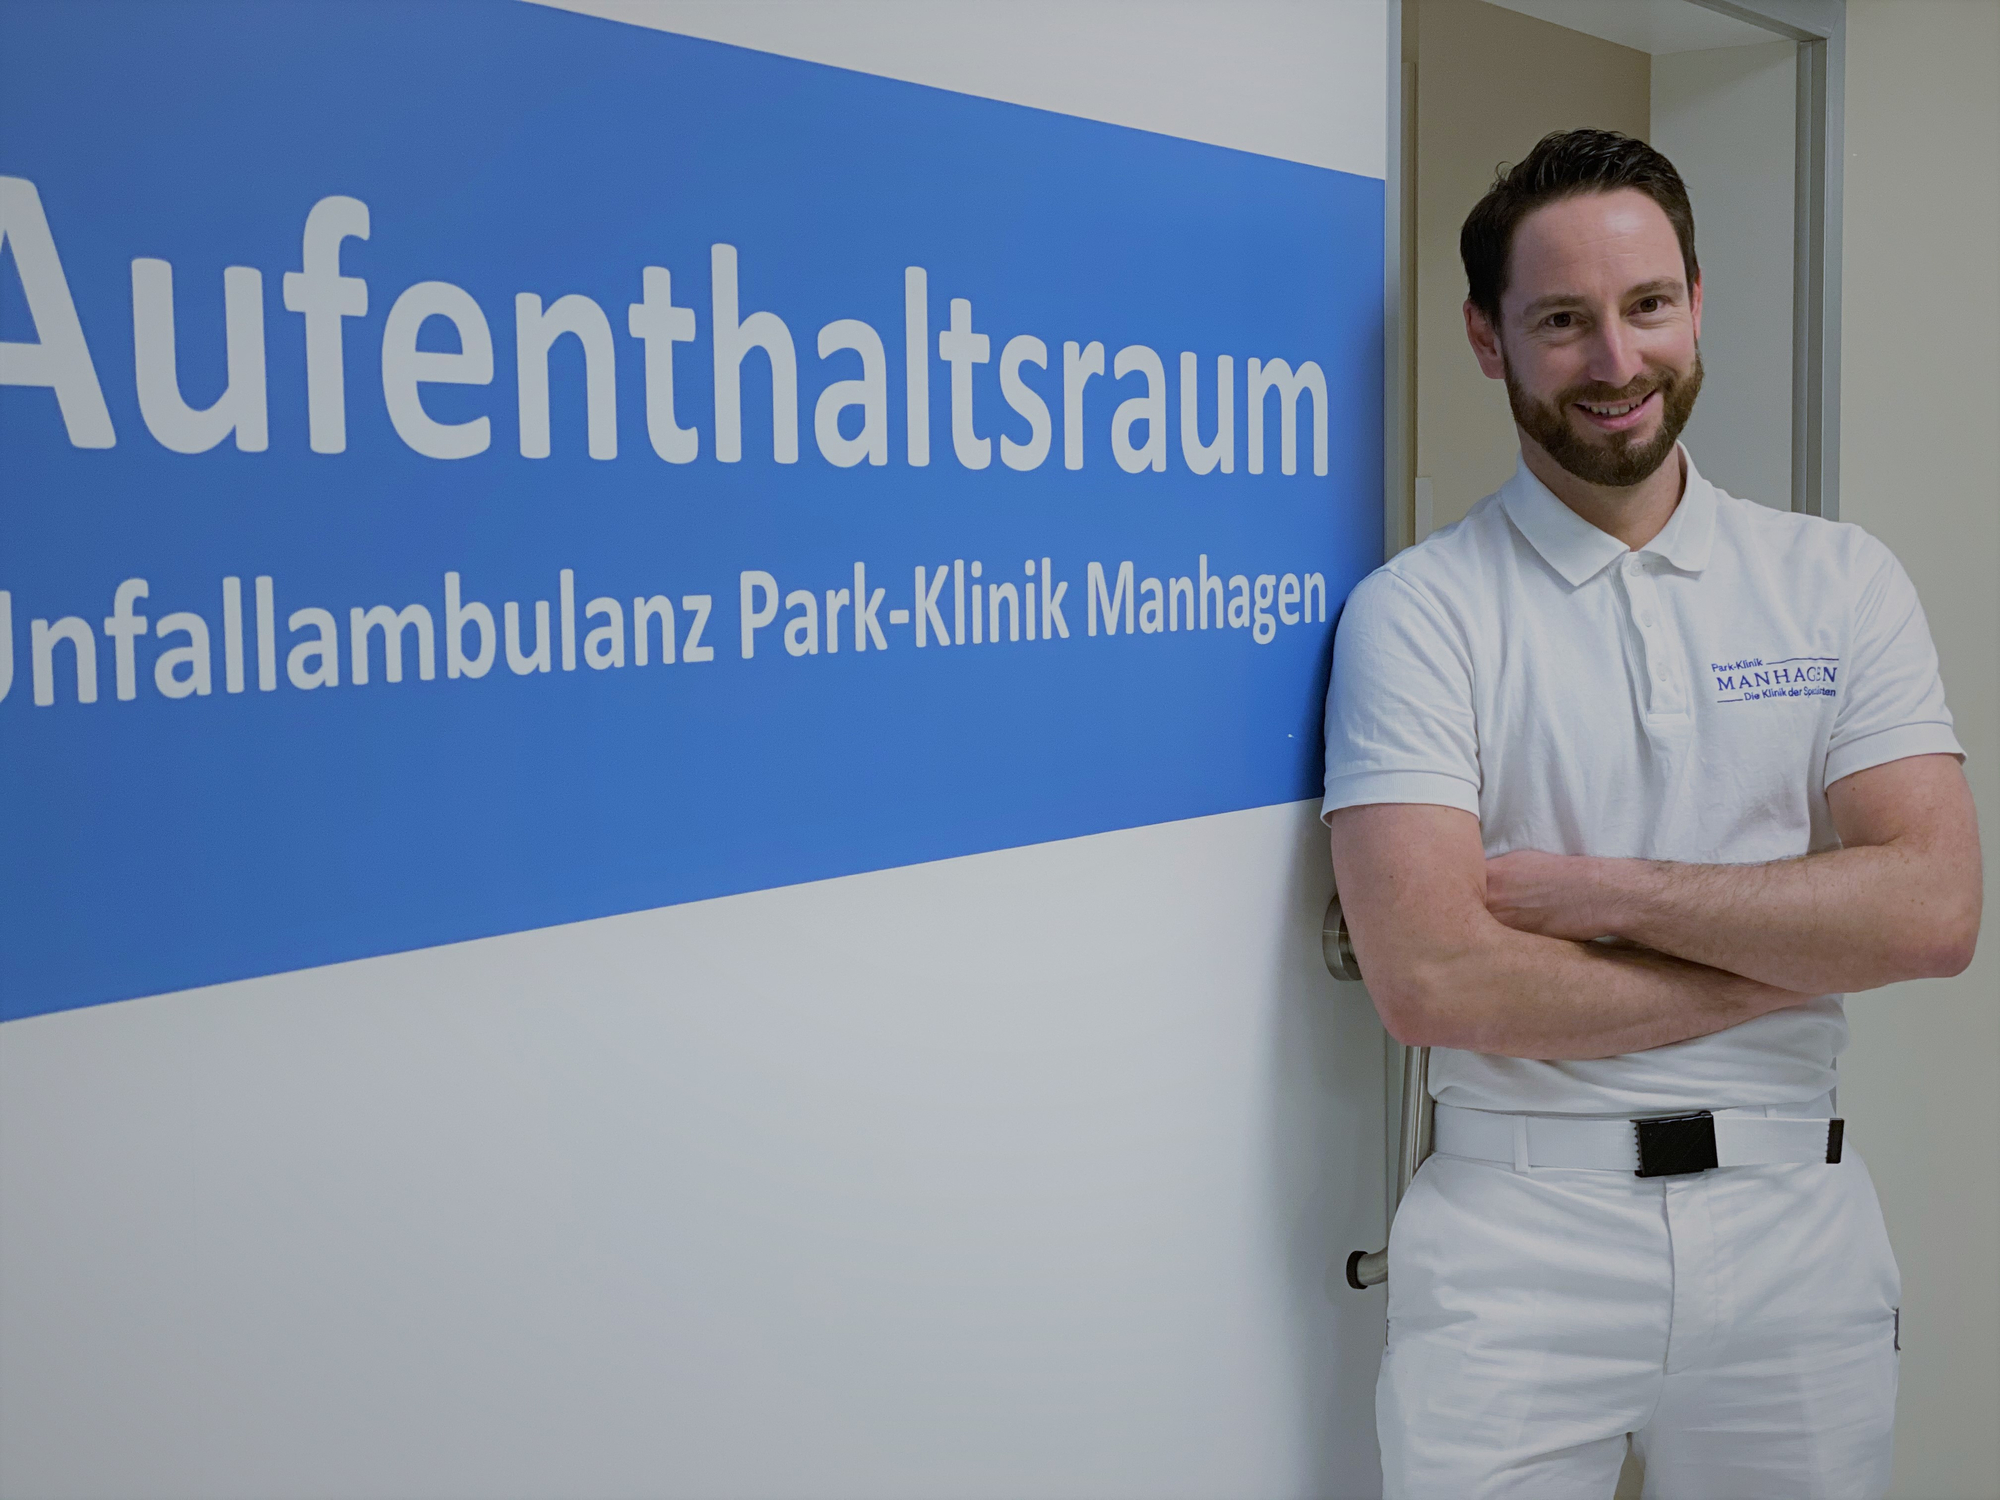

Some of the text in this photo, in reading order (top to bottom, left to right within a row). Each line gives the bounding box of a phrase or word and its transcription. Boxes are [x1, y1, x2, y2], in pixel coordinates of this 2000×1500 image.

[0, 175, 1328, 476] Aufenthaltsraum
[741, 557, 1069, 659] Park-Klinik
[1087, 554, 1326, 644] Manhagen
[1711, 658, 1763, 672] Park-Klinik
[1744, 692, 1760, 701] Die
[1761, 687, 1787, 699] Klinik
[1788, 687, 1802, 697] der
